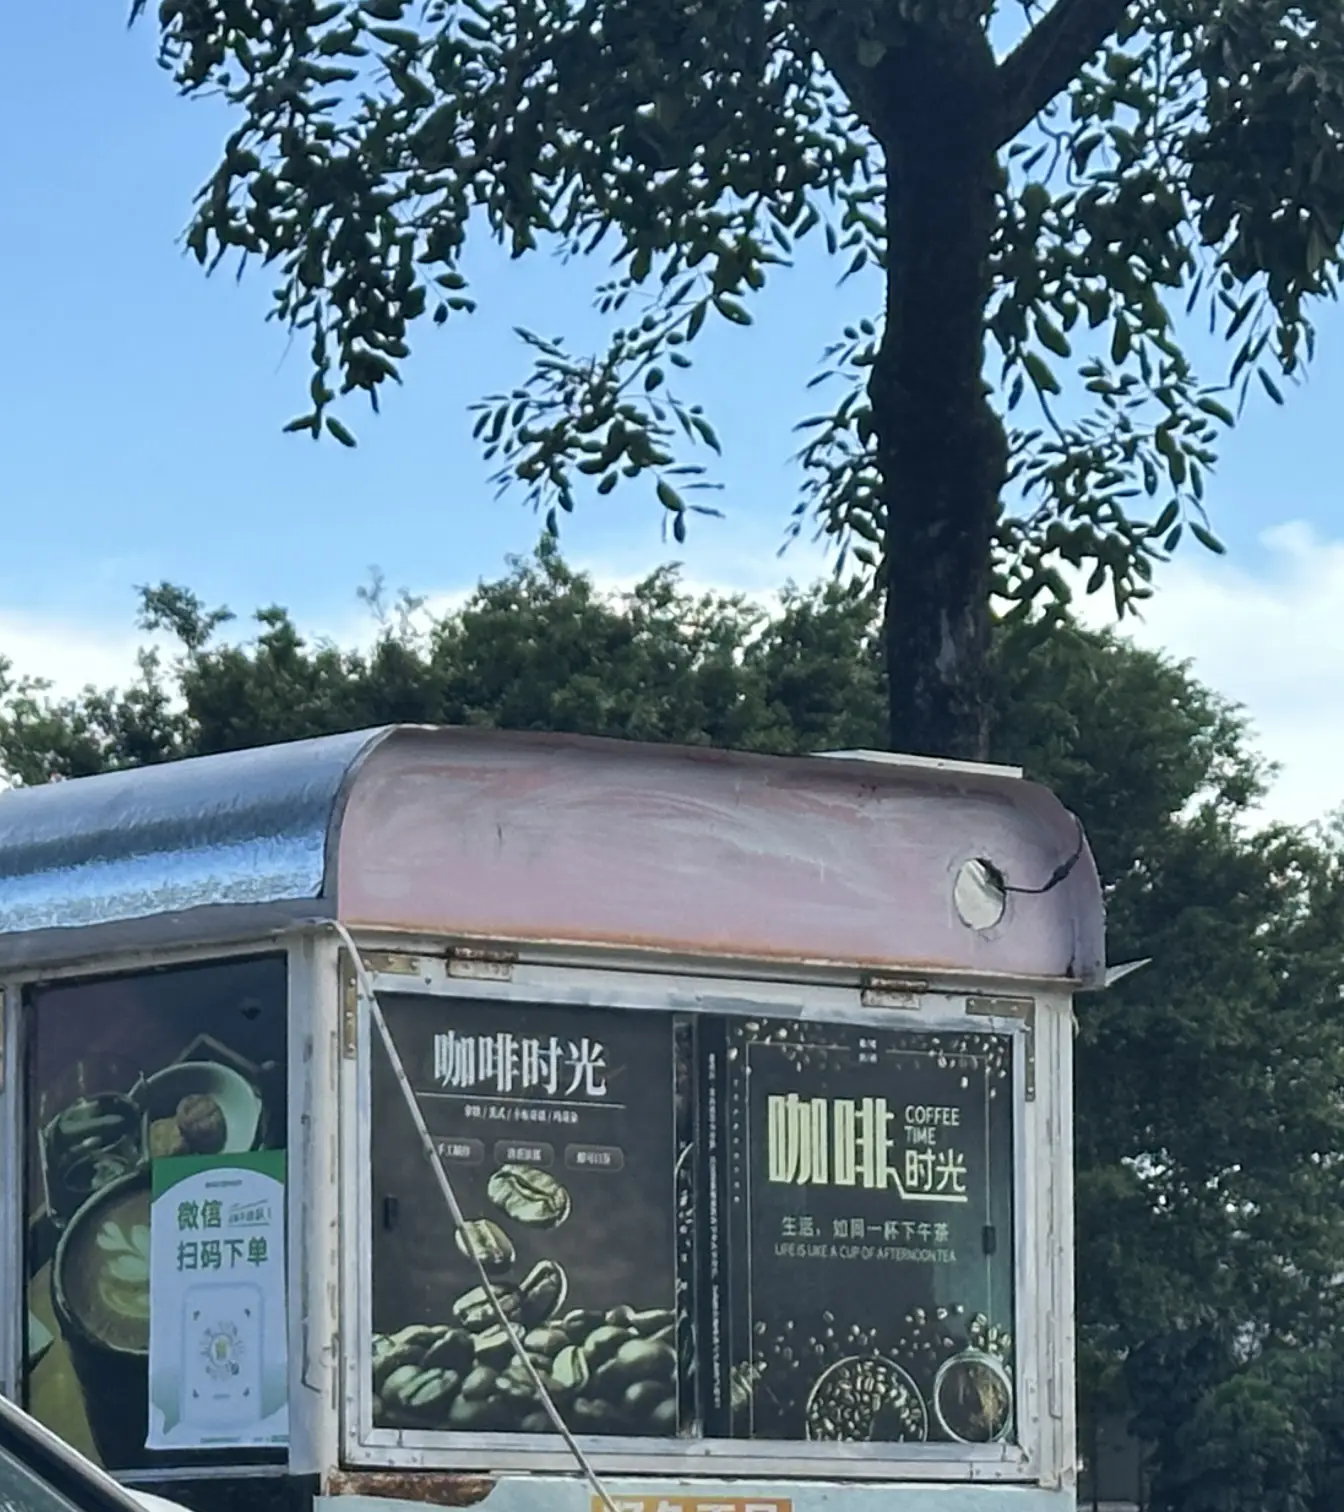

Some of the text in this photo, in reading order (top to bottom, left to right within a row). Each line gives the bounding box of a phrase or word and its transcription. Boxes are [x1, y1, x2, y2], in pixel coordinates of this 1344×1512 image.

[433, 1030, 607, 1096] 咖啡时光
[904, 1104, 960, 1126] COFFEE
[768, 1093, 895, 1188] 咖啡
[904, 1125, 936, 1145] TIME
[905, 1148, 967, 1192] 时光
[177, 1199, 223, 1231] 微信
[176, 1236, 268, 1272] 扫码下单
